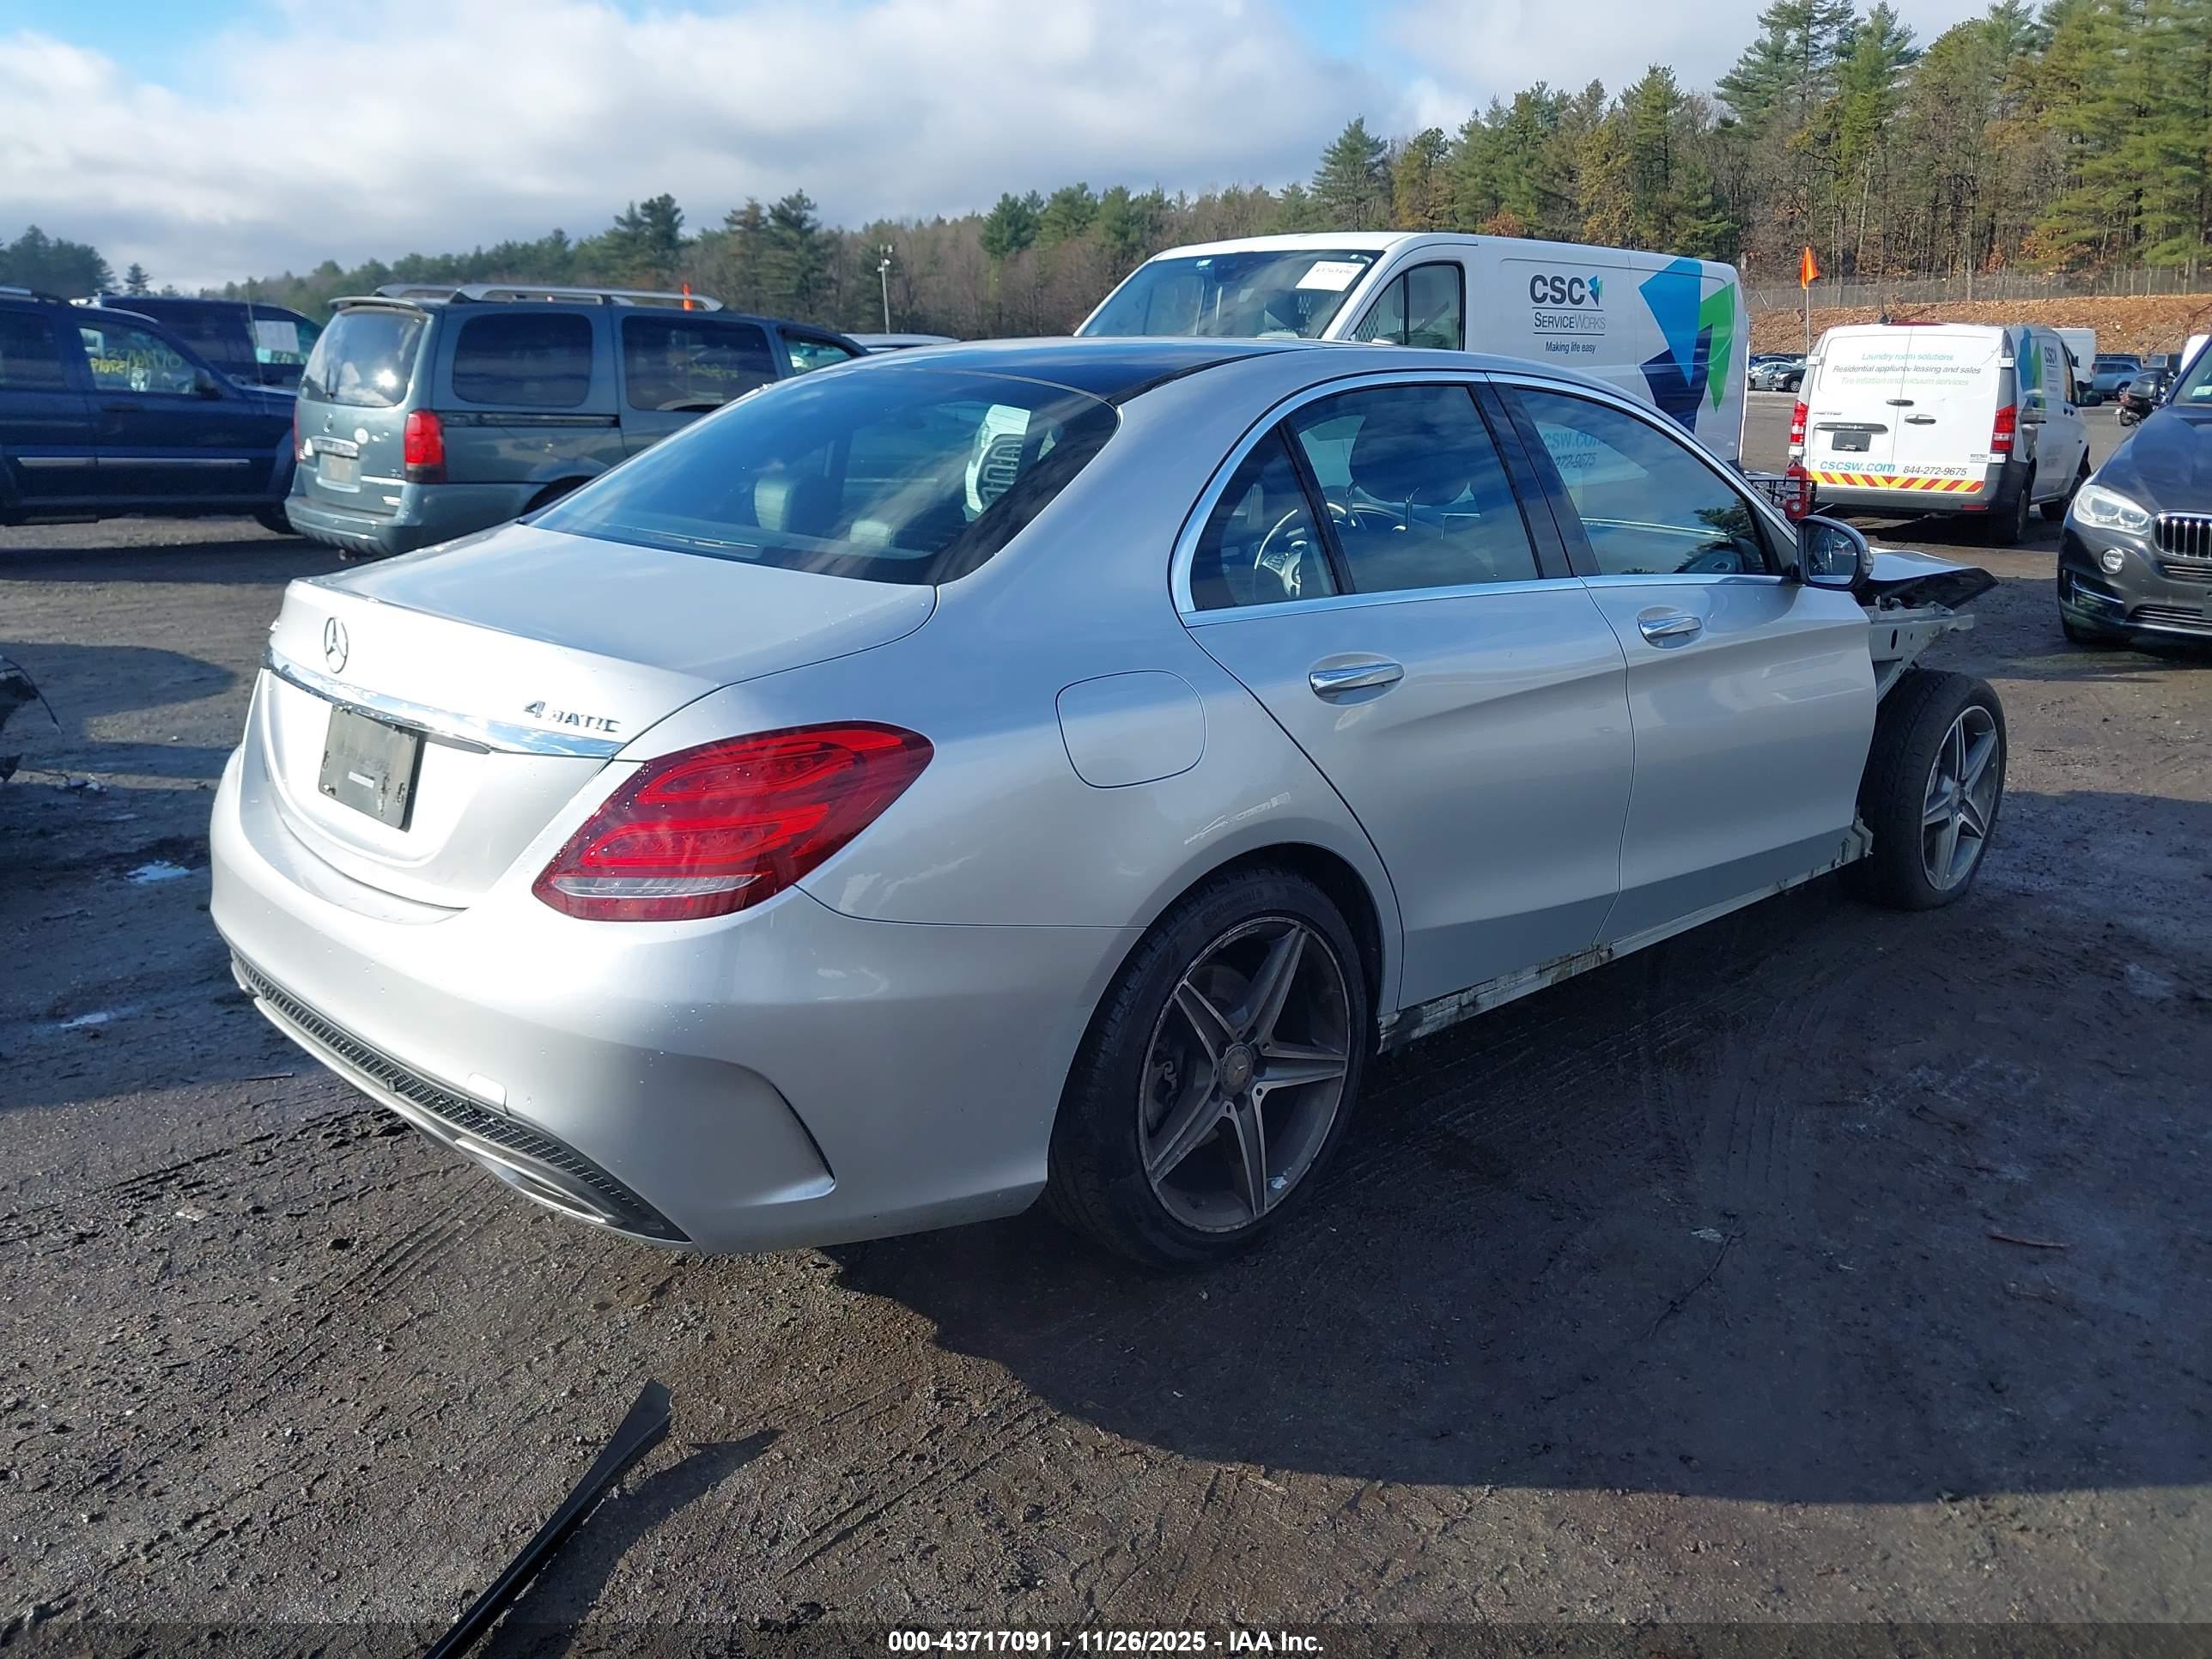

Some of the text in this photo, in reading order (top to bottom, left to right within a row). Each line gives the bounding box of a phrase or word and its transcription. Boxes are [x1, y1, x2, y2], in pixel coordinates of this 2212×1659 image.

[1529, 275, 1585, 305] CSC
[1545, 341, 1596, 354] Making life easy
[1862, 353, 1892, 362] Laundry
[1875, 365, 1911, 374] appliance
[1913, 365, 1941, 374] leasing
[1820, 461, 1896, 472] cscsw.com
[1903, 465, 1967, 476] 844-272-9675
